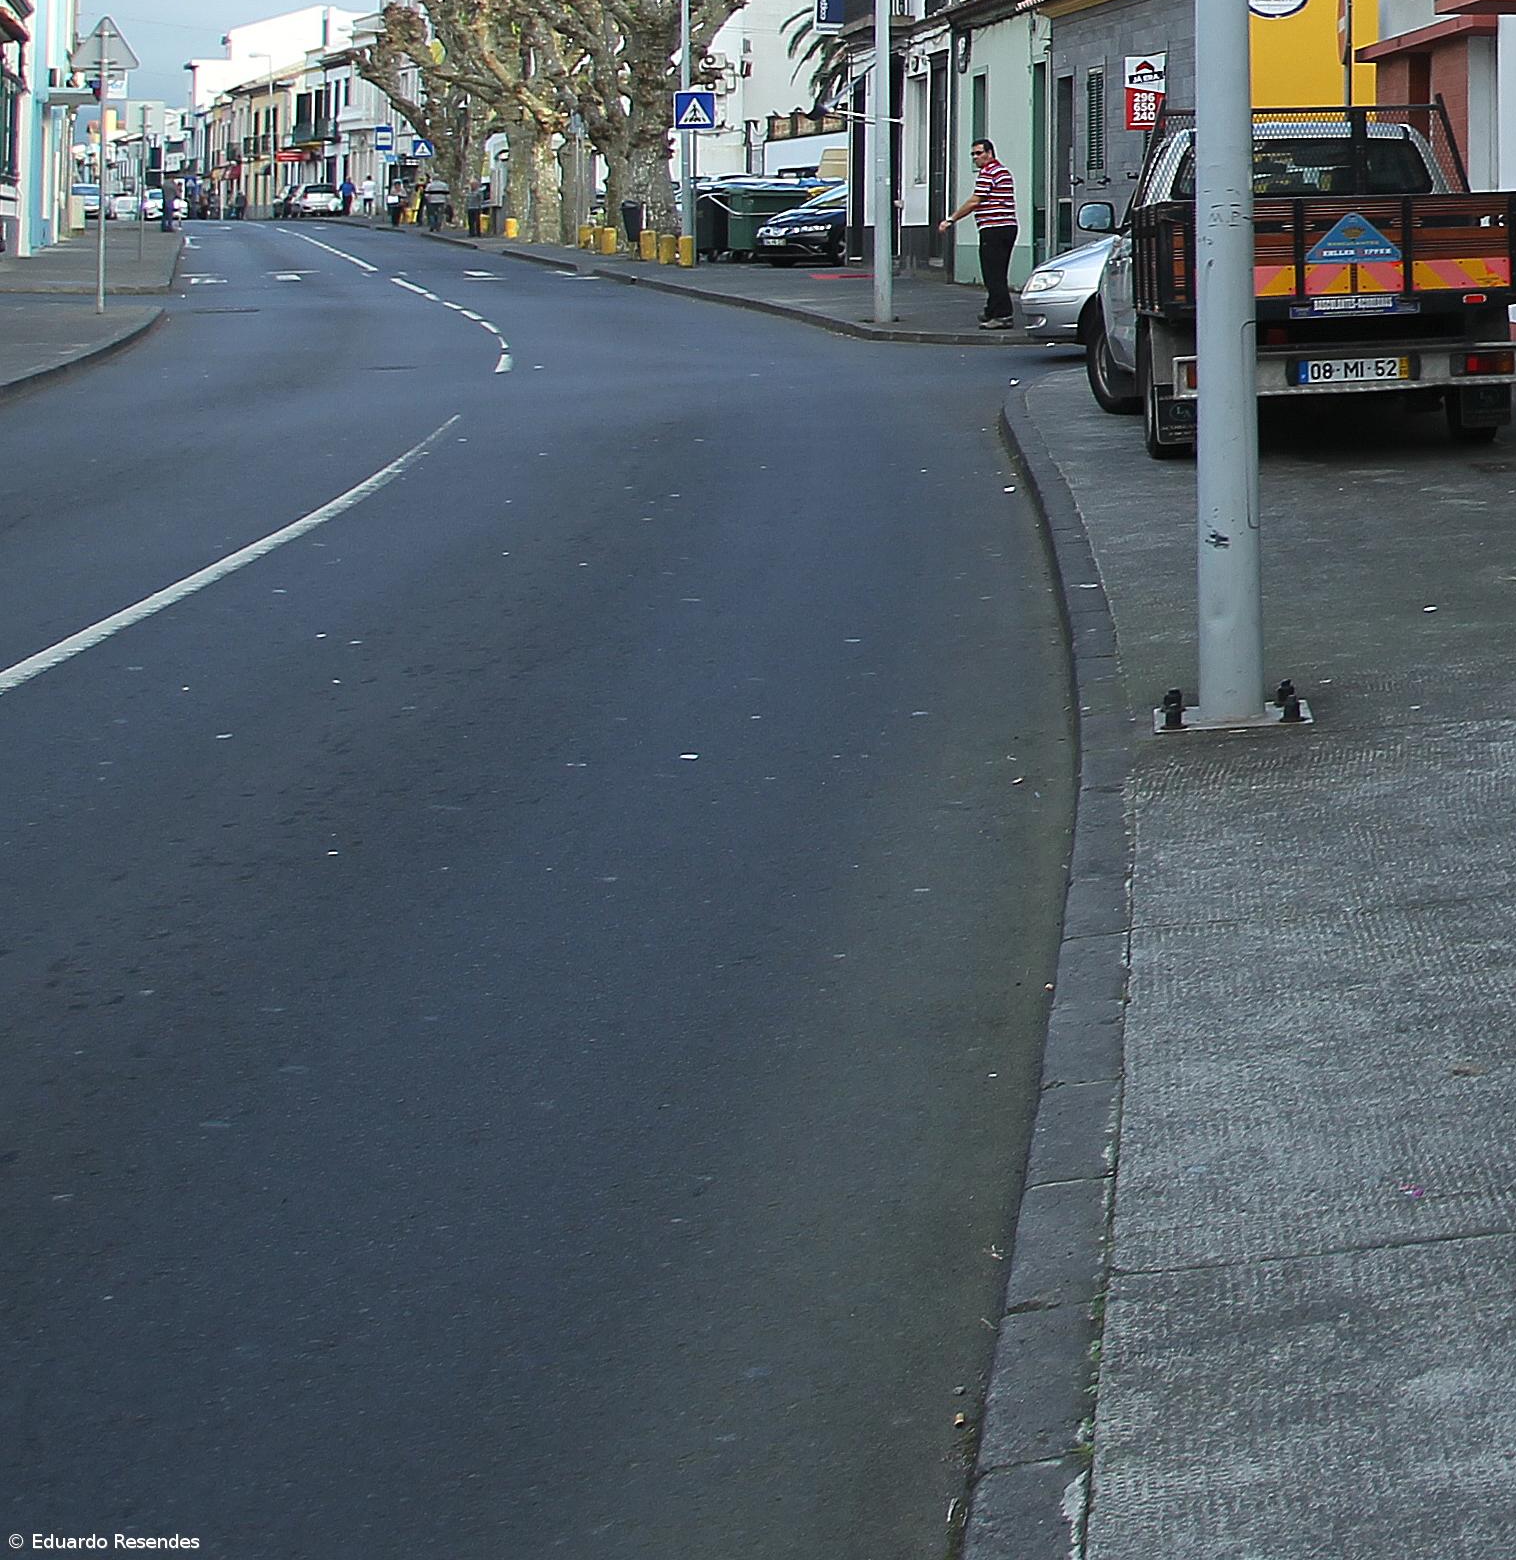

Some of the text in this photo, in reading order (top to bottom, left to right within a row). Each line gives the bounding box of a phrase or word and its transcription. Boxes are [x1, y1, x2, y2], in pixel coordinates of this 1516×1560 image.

[1133, 92, 1156, 102] 296
[1133, 102, 1156, 112] 650
[1133, 111, 1156, 122] 240
